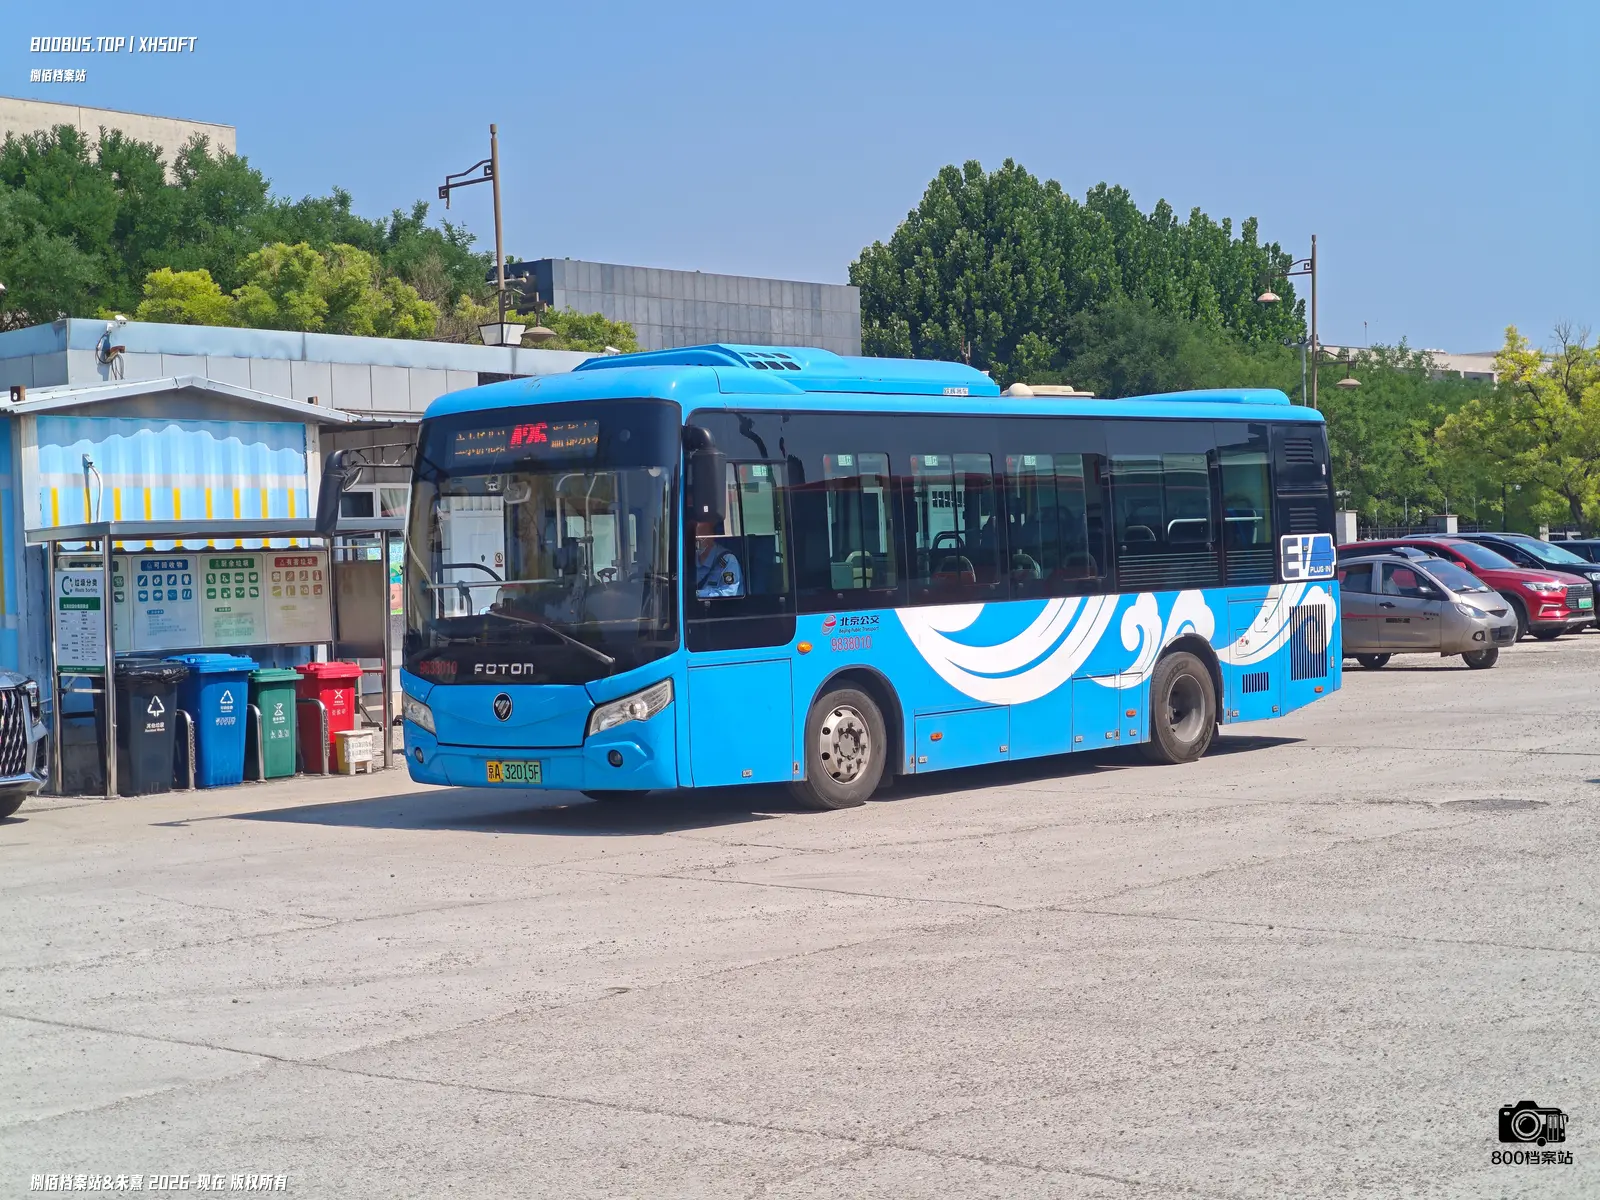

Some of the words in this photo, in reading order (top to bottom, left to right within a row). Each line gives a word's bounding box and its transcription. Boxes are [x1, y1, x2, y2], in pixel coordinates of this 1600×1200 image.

[153, 561, 183, 569] 可回收物
[74, 578, 98, 587] 垃圾分类
[840, 615, 879, 626] 北京公交
[831, 635, 872, 652] 9838010
[474, 663, 534, 675] FOTON
